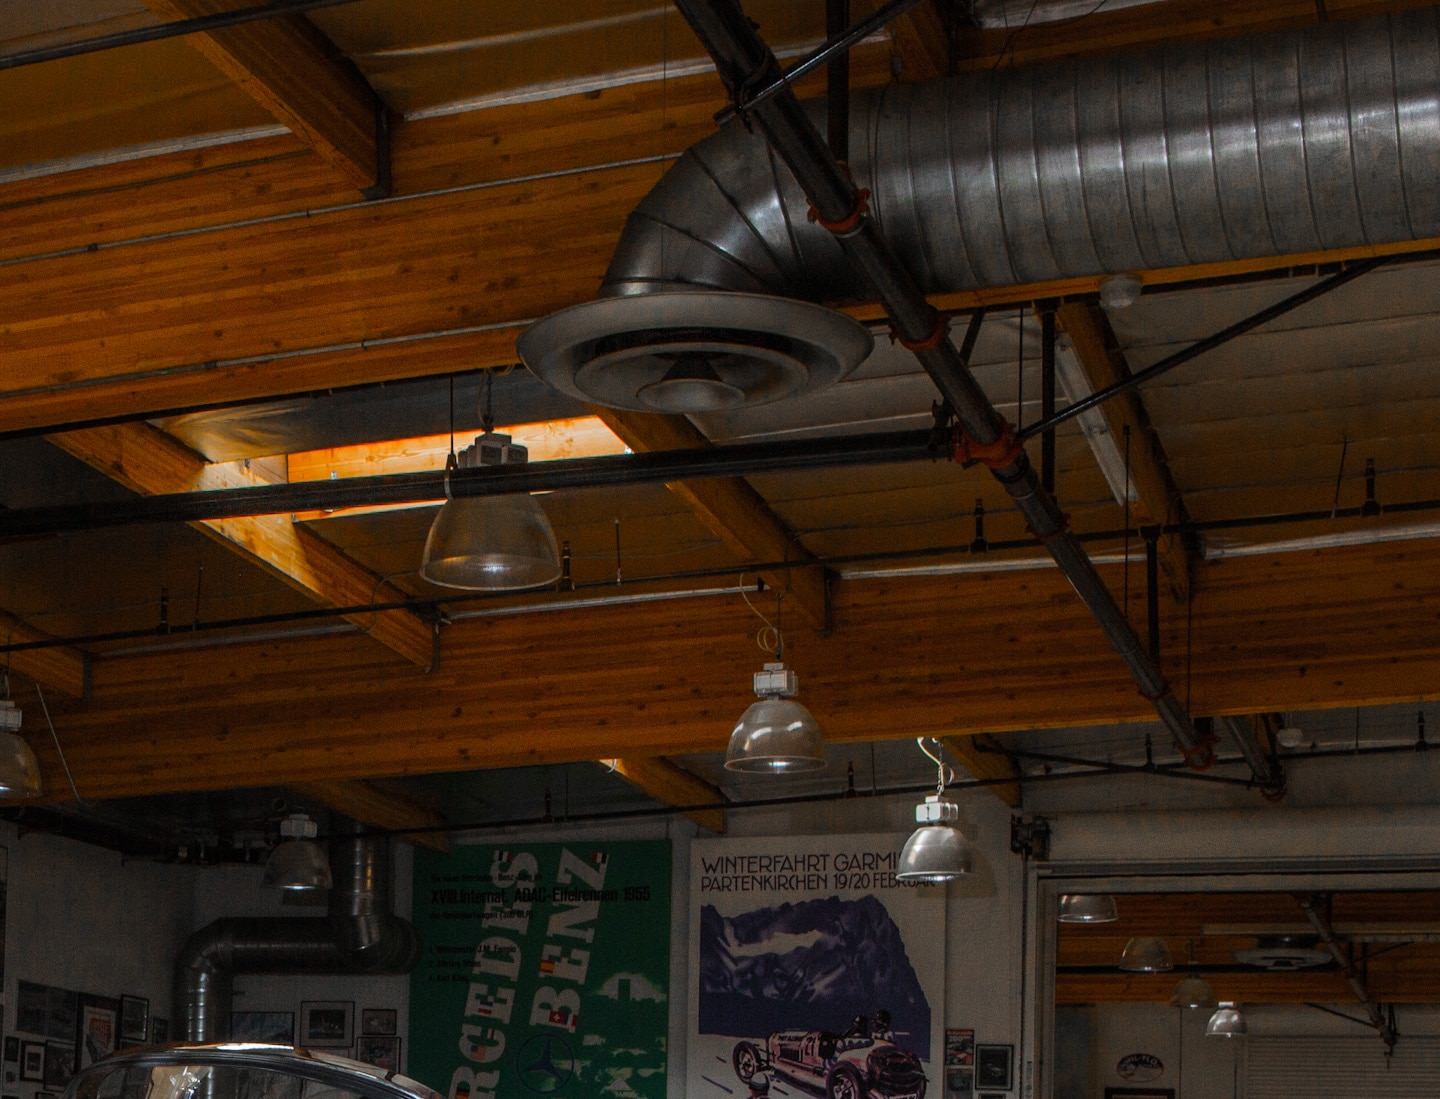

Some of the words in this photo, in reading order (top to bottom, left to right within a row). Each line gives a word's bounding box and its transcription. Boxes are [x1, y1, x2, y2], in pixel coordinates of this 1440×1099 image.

[701, 854, 830, 874] WINTERFAHRT
[834, 852, 902, 871] GARMI
[701, 873, 828, 891] PARTENKIRCHEN
[833, 872, 870, 889] 19/20
[623, 886, 651, 901] 1955
[529, 846, 610, 1035] BENZ
